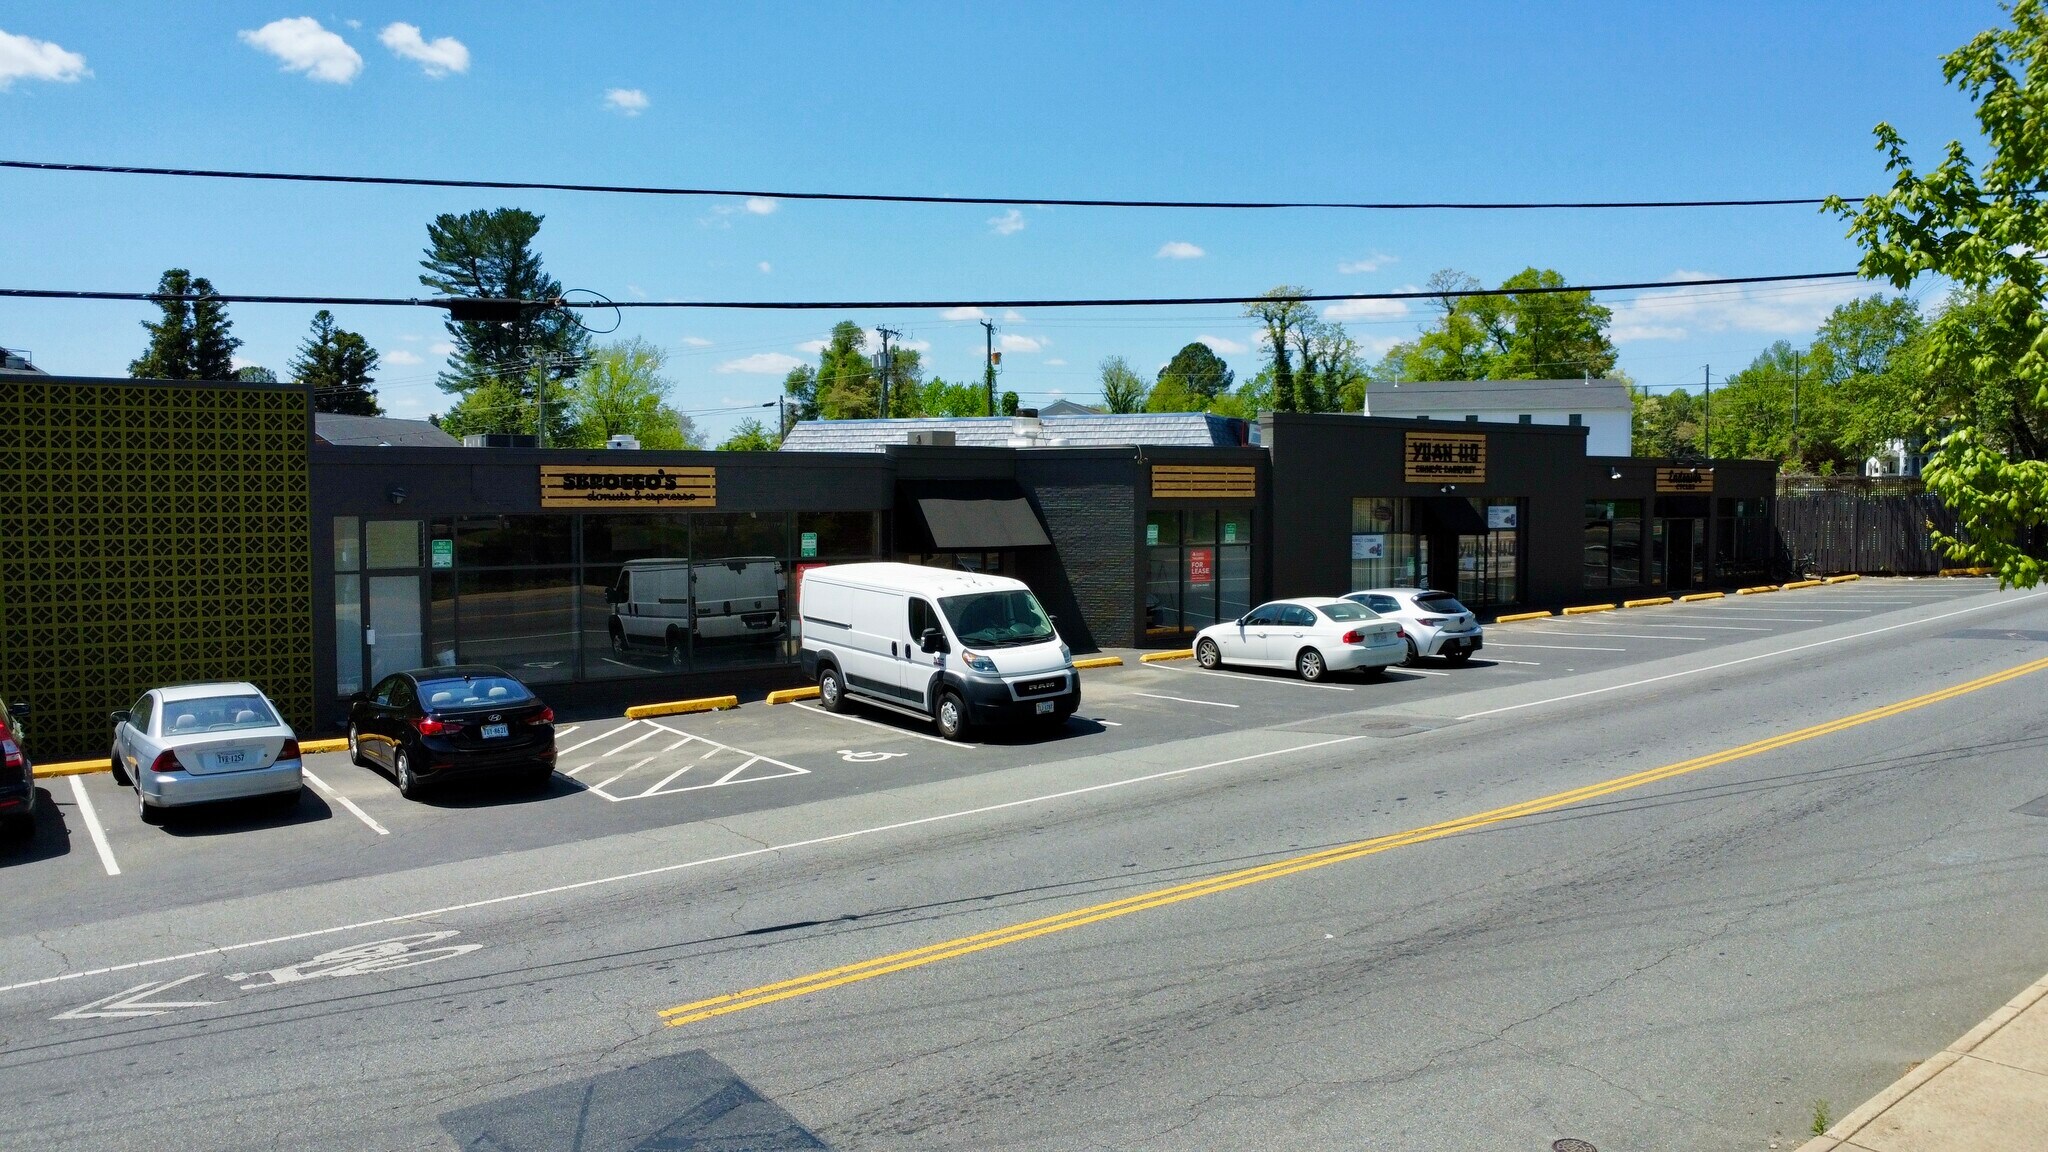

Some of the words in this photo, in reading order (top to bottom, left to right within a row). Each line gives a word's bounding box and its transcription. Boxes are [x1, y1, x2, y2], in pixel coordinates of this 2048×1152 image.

[563, 469, 677, 490] SBROCCO'S
[587, 491, 632, 502] donuts
[634, 490, 642, 501] &
[645, 492, 696, 504] espresso
[1191, 567, 1210, 575] LEASE
[1028, 682, 1055, 690] RAM
